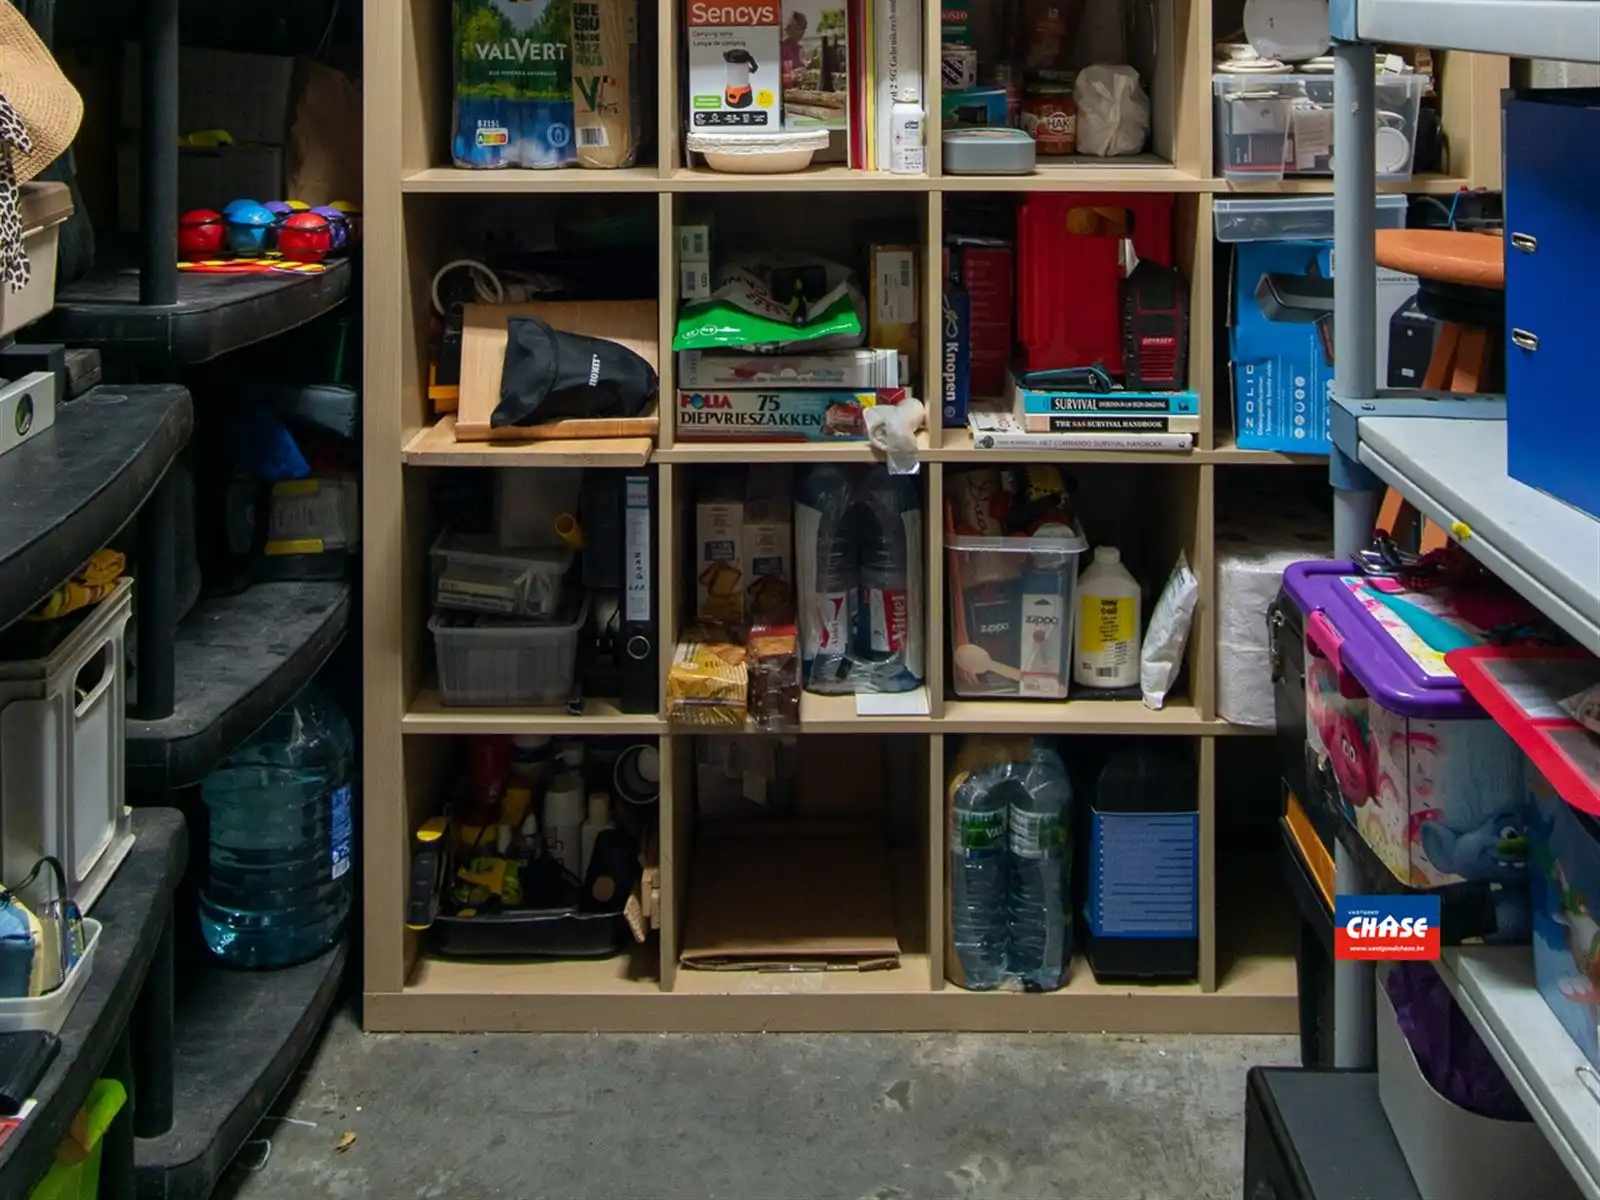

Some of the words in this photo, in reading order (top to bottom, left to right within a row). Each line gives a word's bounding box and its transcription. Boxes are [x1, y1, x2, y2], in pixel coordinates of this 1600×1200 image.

[691, 2, 774, 26] Sencys
[574, 17, 600, 31] EAU
[475, 38, 569, 62] VALVERT
[946, 341, 959, 402] Knopen
[757, 395, 781, 411] 75
[1054, 398, 1098, 410] SURVIVAL
[680, 411, 822, 426] DIEPVRIESZAKKEN
[1055, 420, 1071, 428] THE
[1087, 420, 1122, 429] SURVIVAL
[1025, 614, 1059, 625] zippo
[980, 622, 1009, 634] zippo
